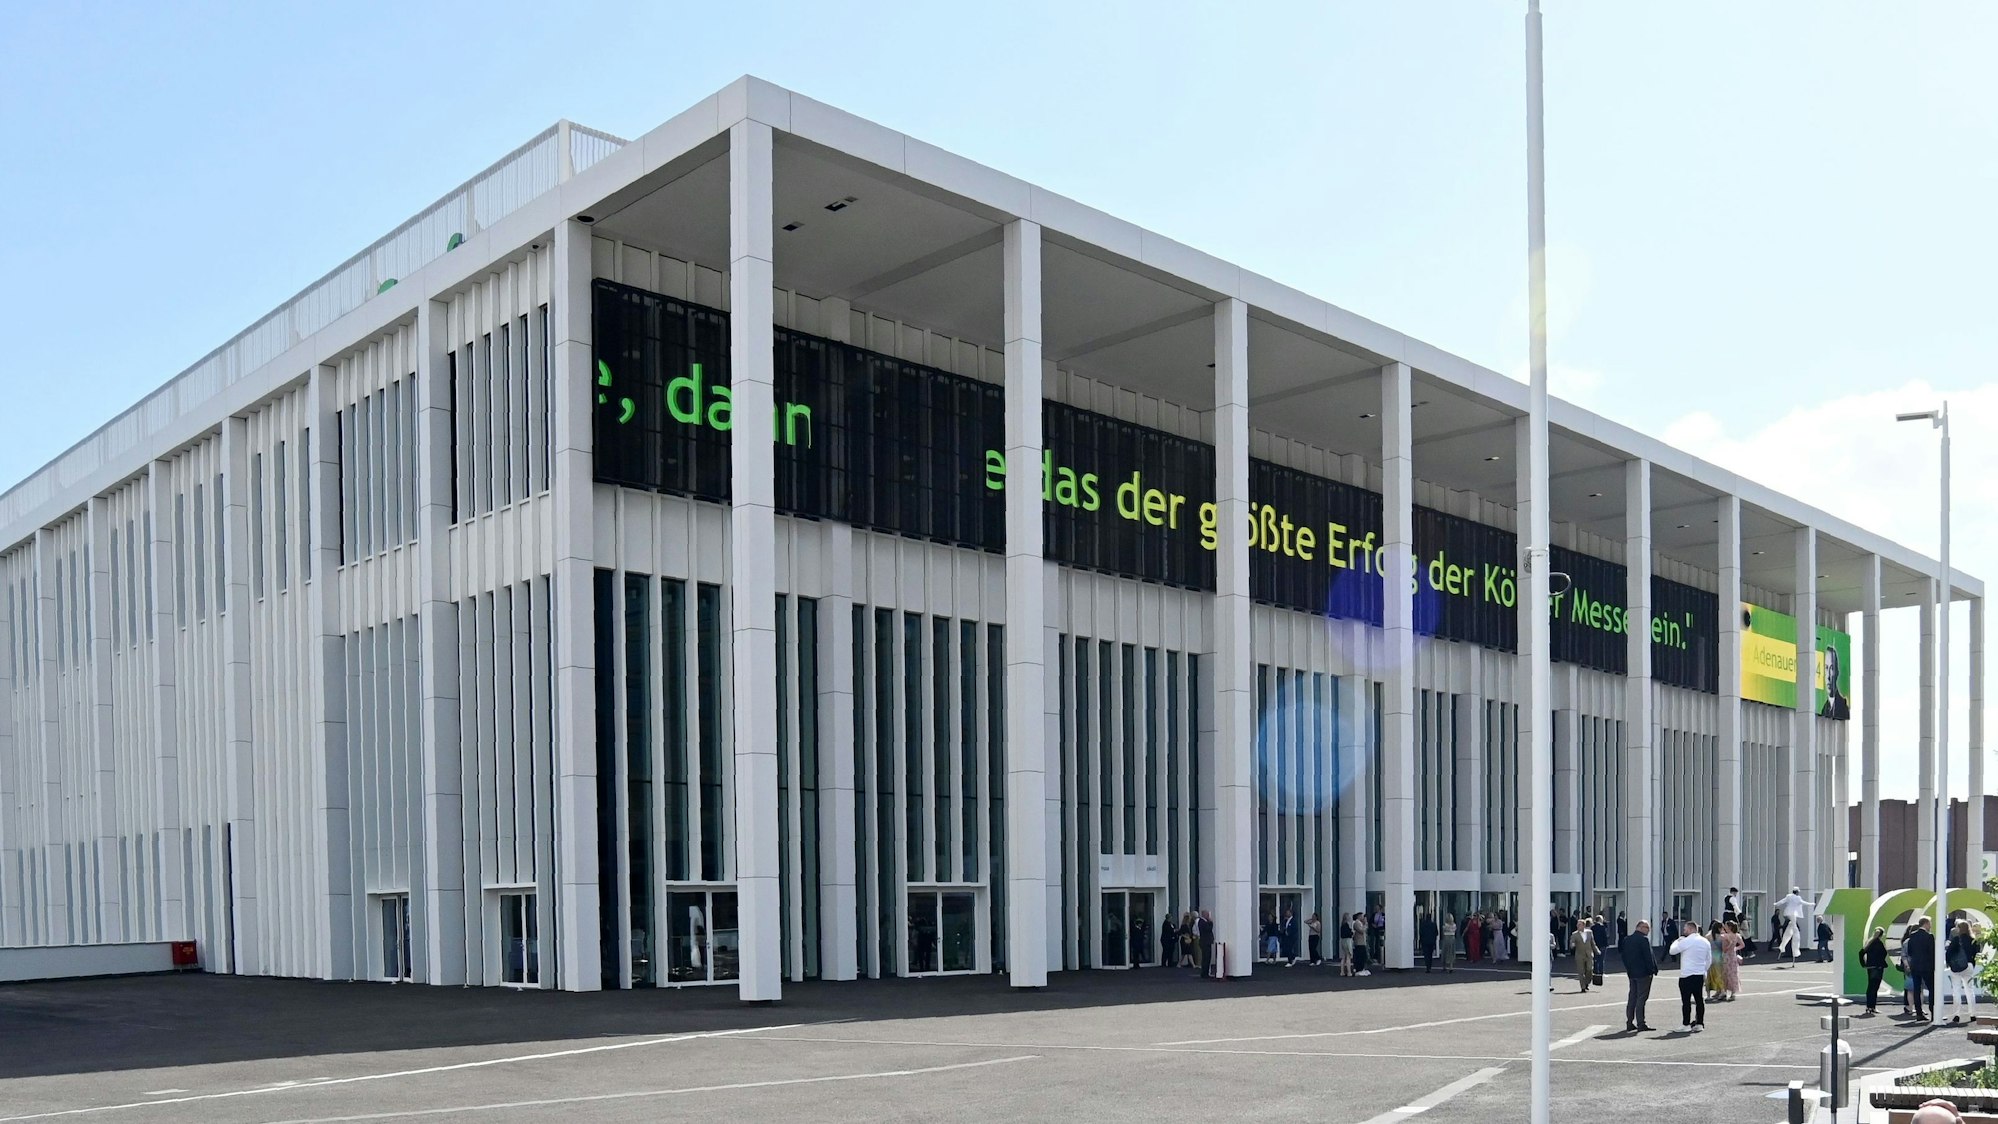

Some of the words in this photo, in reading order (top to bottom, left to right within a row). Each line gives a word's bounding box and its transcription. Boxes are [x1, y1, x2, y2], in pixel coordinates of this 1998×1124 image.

[666, 363, 812, 449] dan
[1117, 471, 1185, 529] der
[1200, 502, 1316, 560] gößte
[1429, 551, 1475, 597] der
